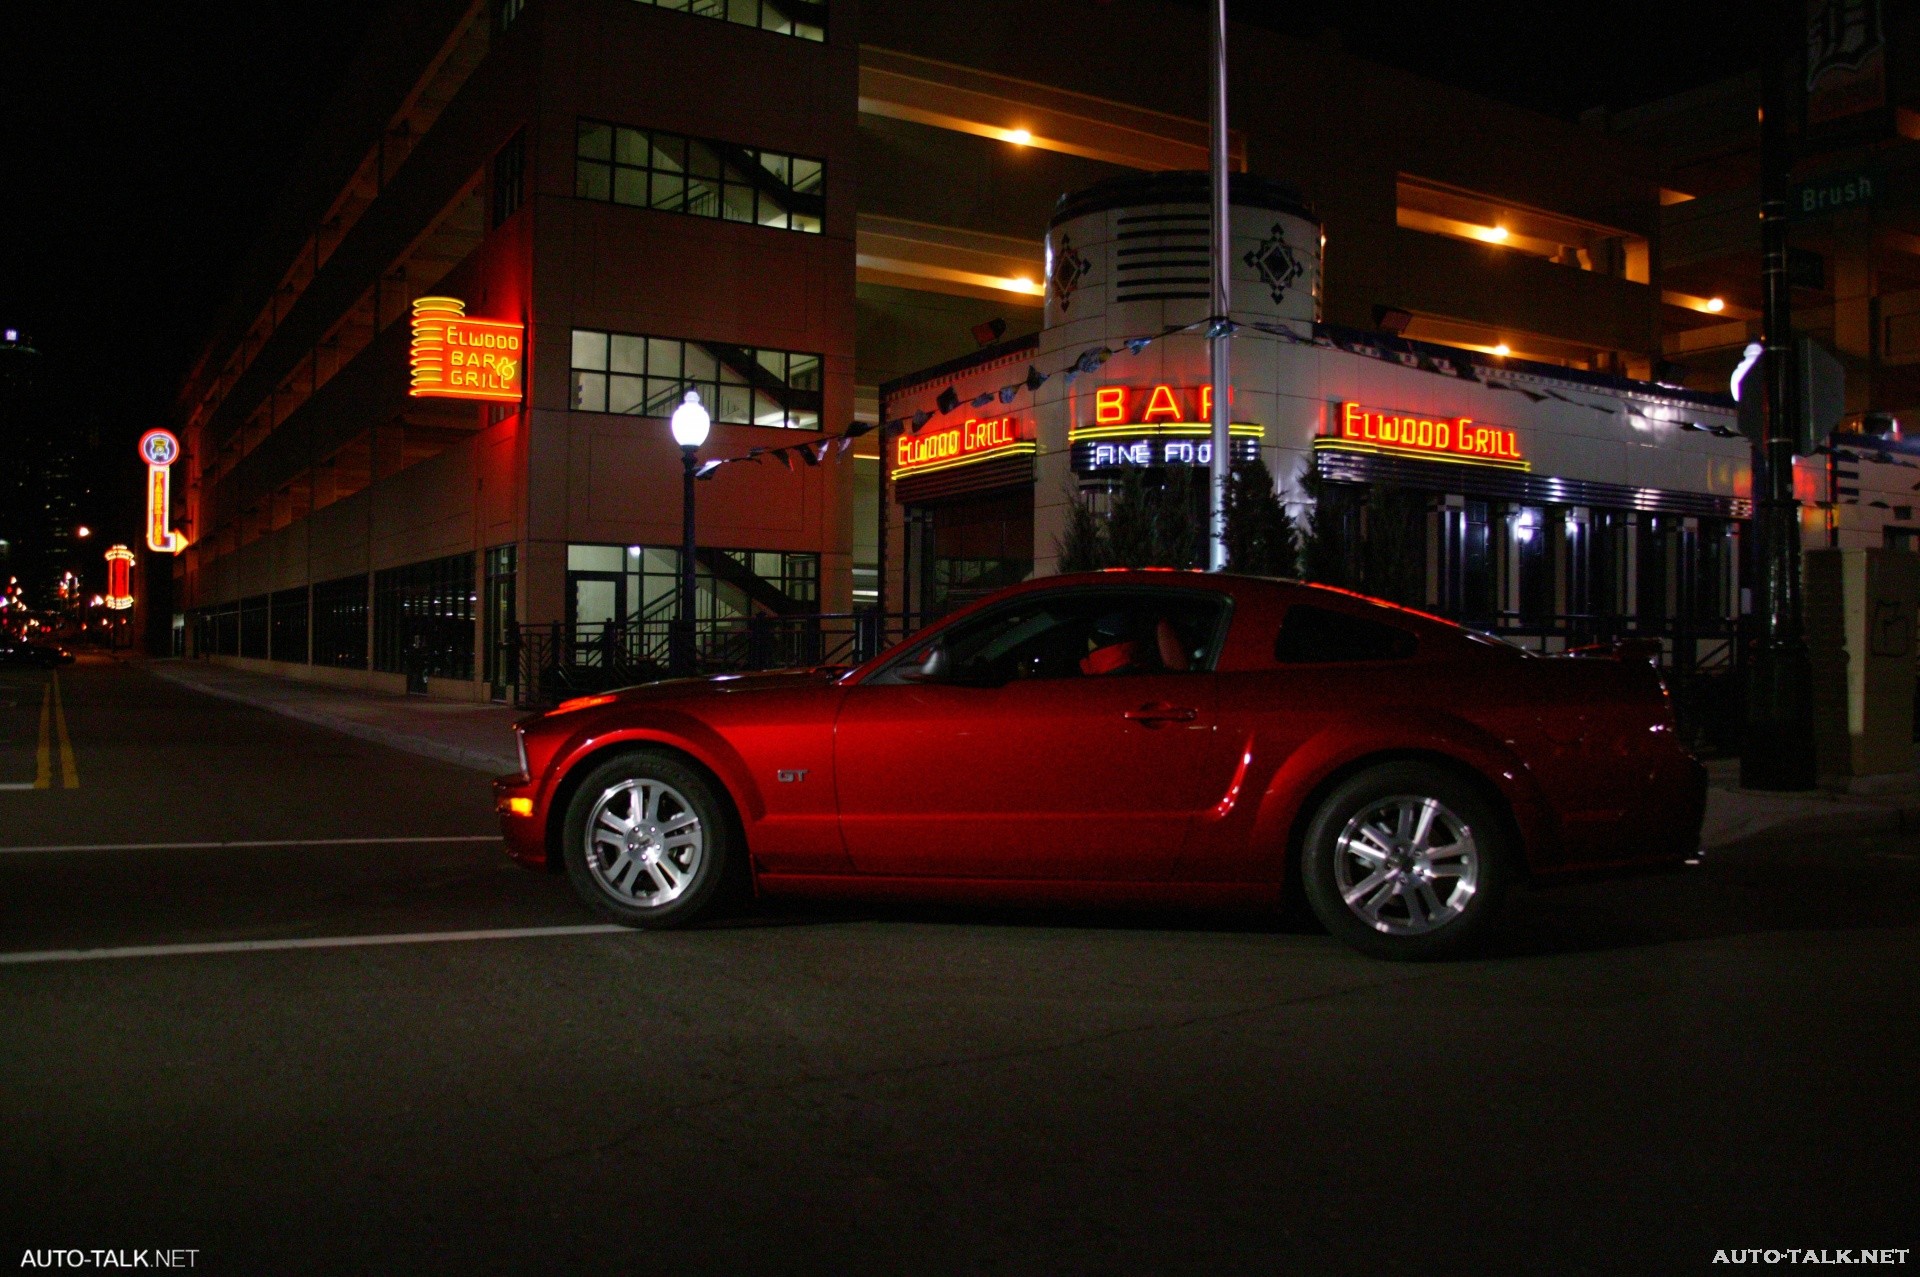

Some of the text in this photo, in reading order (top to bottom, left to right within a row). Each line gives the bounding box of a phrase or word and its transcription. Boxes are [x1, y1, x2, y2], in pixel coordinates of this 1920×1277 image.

[1802, 176, 1872, 212] Brush
[446, 326, 519, 350] ELWOOD
[450, 351, 518, 380] BAR &
[450, 370, 510, 389] GRILL
[897, 418, 1013, 466] ELWOOD GRILL
[1345, 402, 1520, 458] ELWOOD GRILL
[1096, 443, 1212, 465] FINE FOO
[153, 470, 165, 546] PARKING
[777, 769, 808, 782] GT
